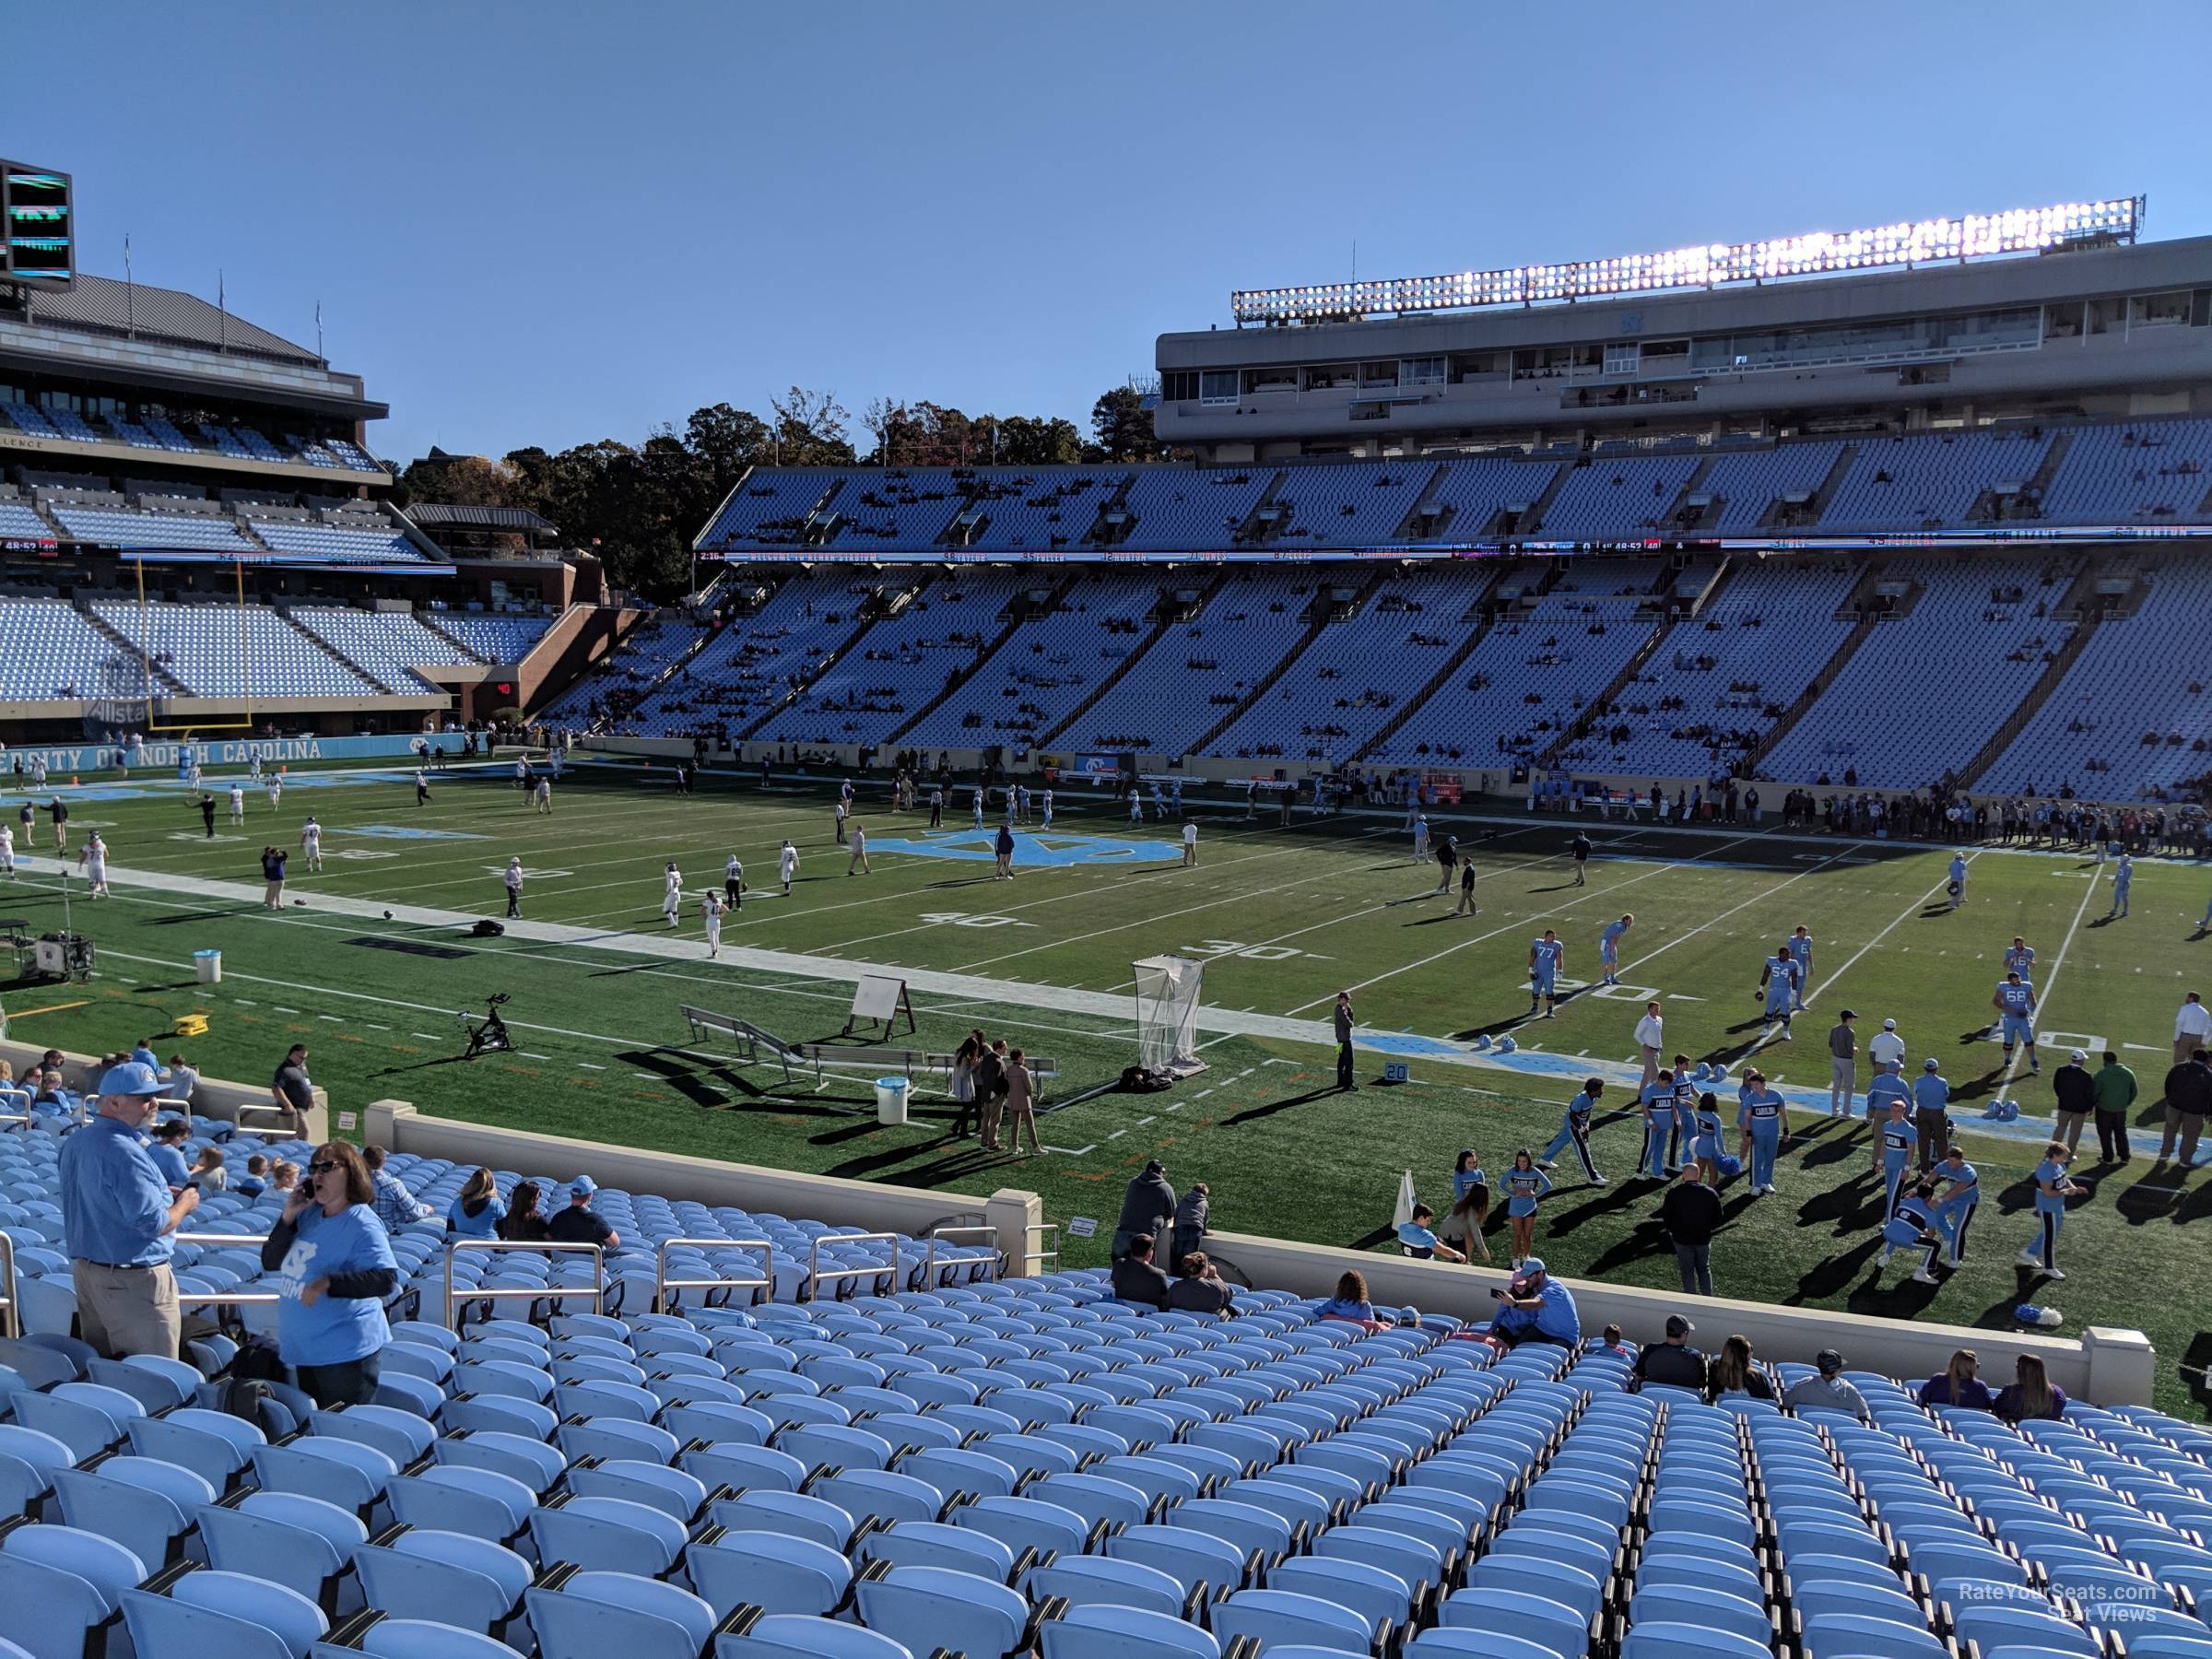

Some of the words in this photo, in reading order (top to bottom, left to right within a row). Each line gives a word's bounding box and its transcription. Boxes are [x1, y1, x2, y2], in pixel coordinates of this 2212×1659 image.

[499, 683, 511, 694] 40
[139, 744, 210, 767] NORH
[1180, 940, 1303, 959] 30
[1538, 946, 1555, 959] 77
[2013, 956, 2027, 966] 16
[1771, 966, 1790, 979] 54
[2006, 991, 2027, 1003] 68
[1387, 1065, 1406, 1079] 20
